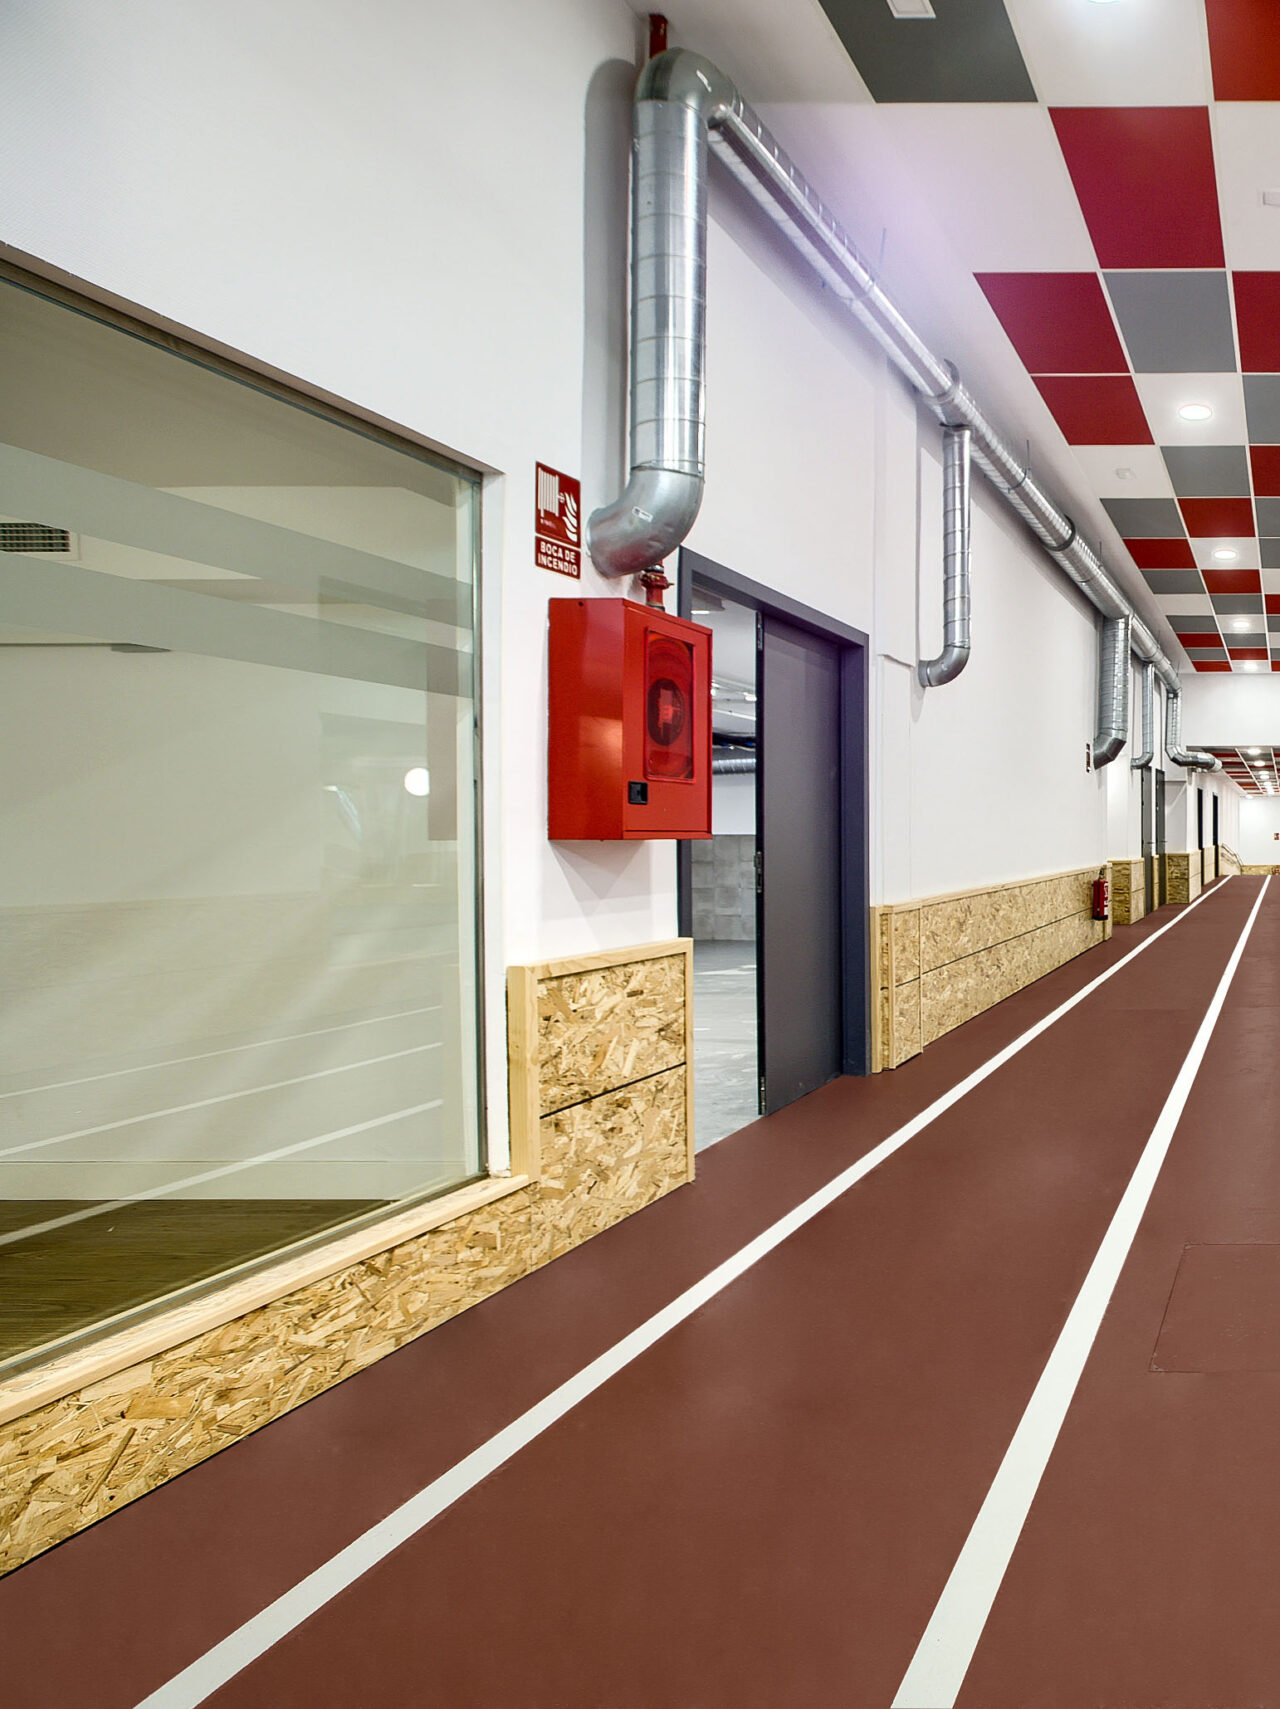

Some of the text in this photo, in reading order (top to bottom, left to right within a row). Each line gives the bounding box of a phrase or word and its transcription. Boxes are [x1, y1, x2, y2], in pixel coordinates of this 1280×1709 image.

[540, 541, 576, 563] BOCA DE
[538, 553, 578, 576] INCENDIO
